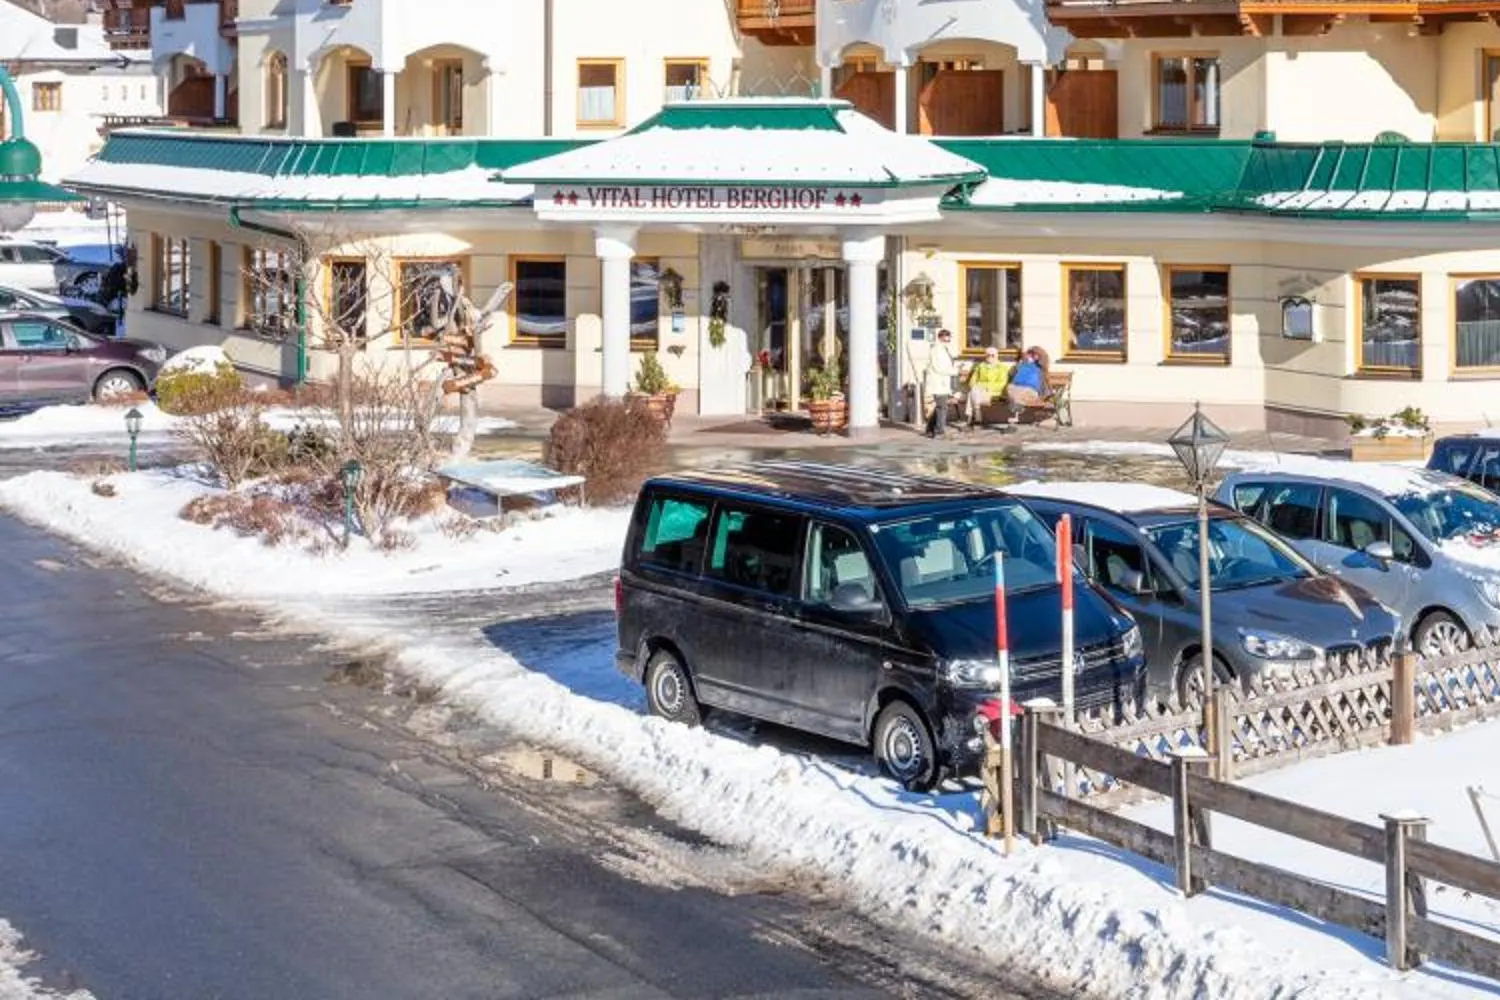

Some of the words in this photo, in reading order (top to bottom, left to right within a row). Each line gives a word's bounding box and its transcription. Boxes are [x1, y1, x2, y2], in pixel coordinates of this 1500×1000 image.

[587, 187, 646, 208] VITAL
[652, 187, 721, 208] HOTEL
[727, 187, 828, 209] BERGHOF
